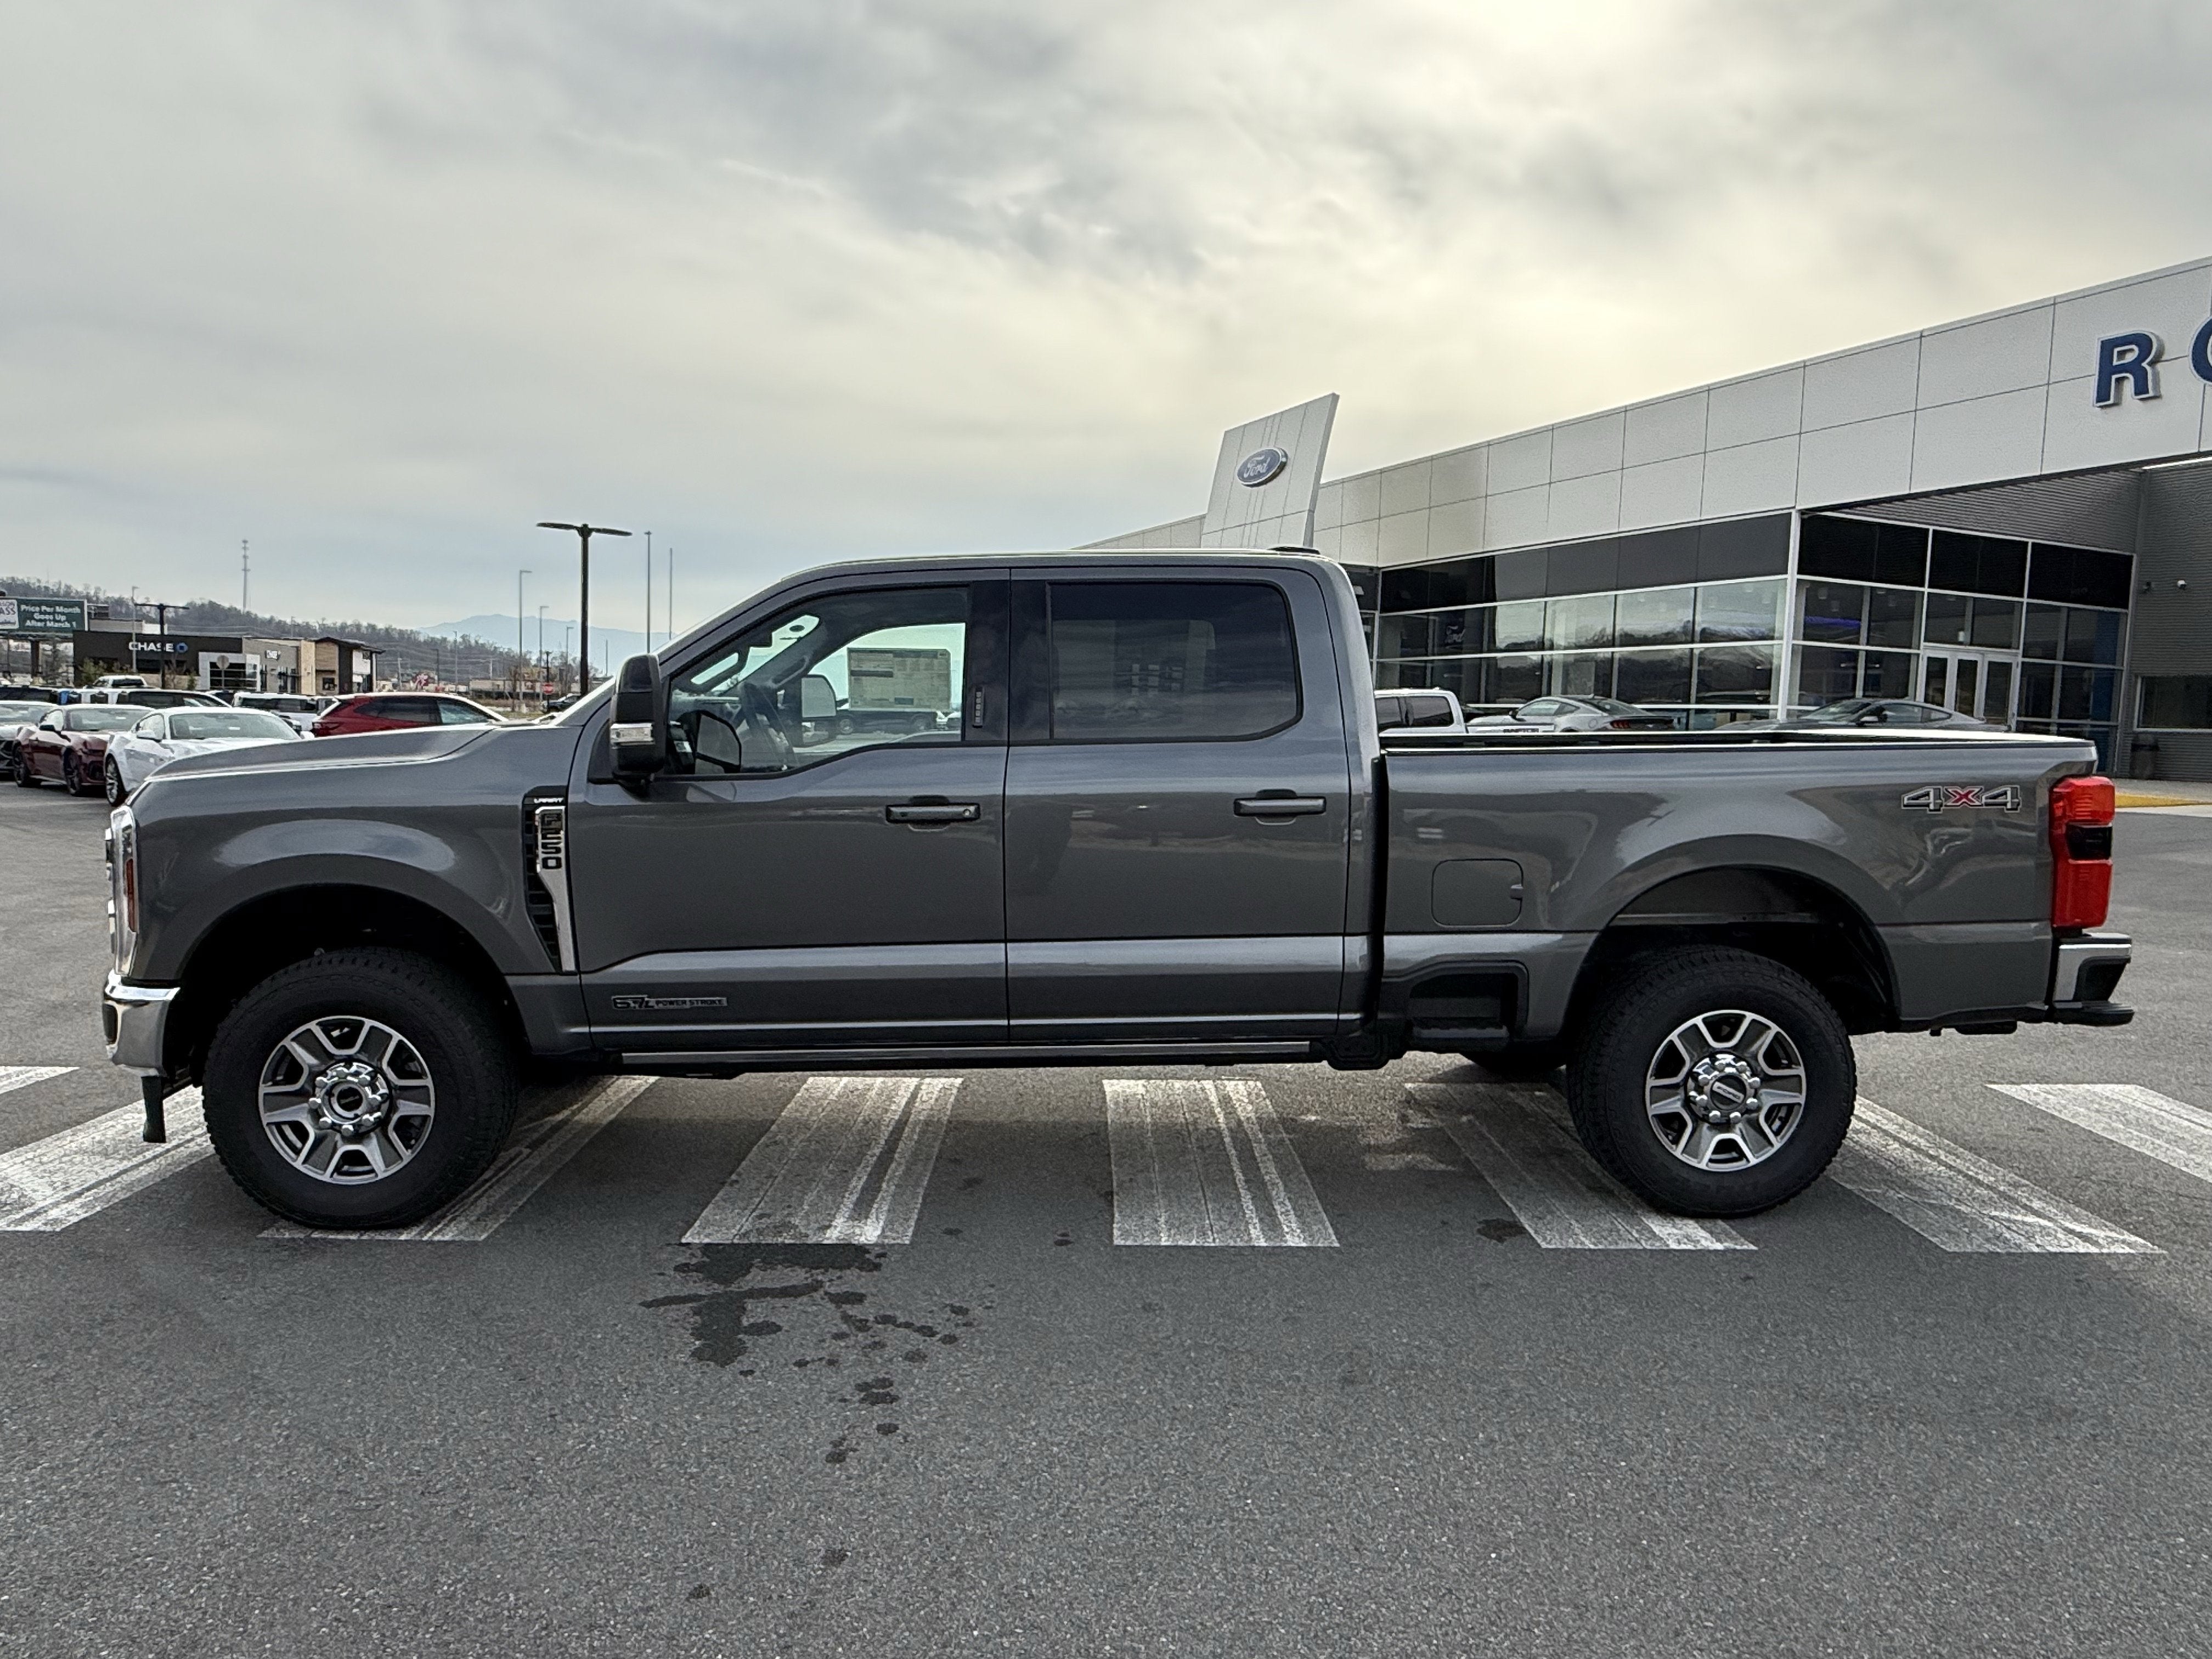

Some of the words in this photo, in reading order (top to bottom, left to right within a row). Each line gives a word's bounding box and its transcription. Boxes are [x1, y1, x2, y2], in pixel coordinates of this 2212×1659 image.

[1243, 455, 1271, 478] Ford
[55, 613, 66, 622] Up
[128, 642, 174, 652] CHASE
